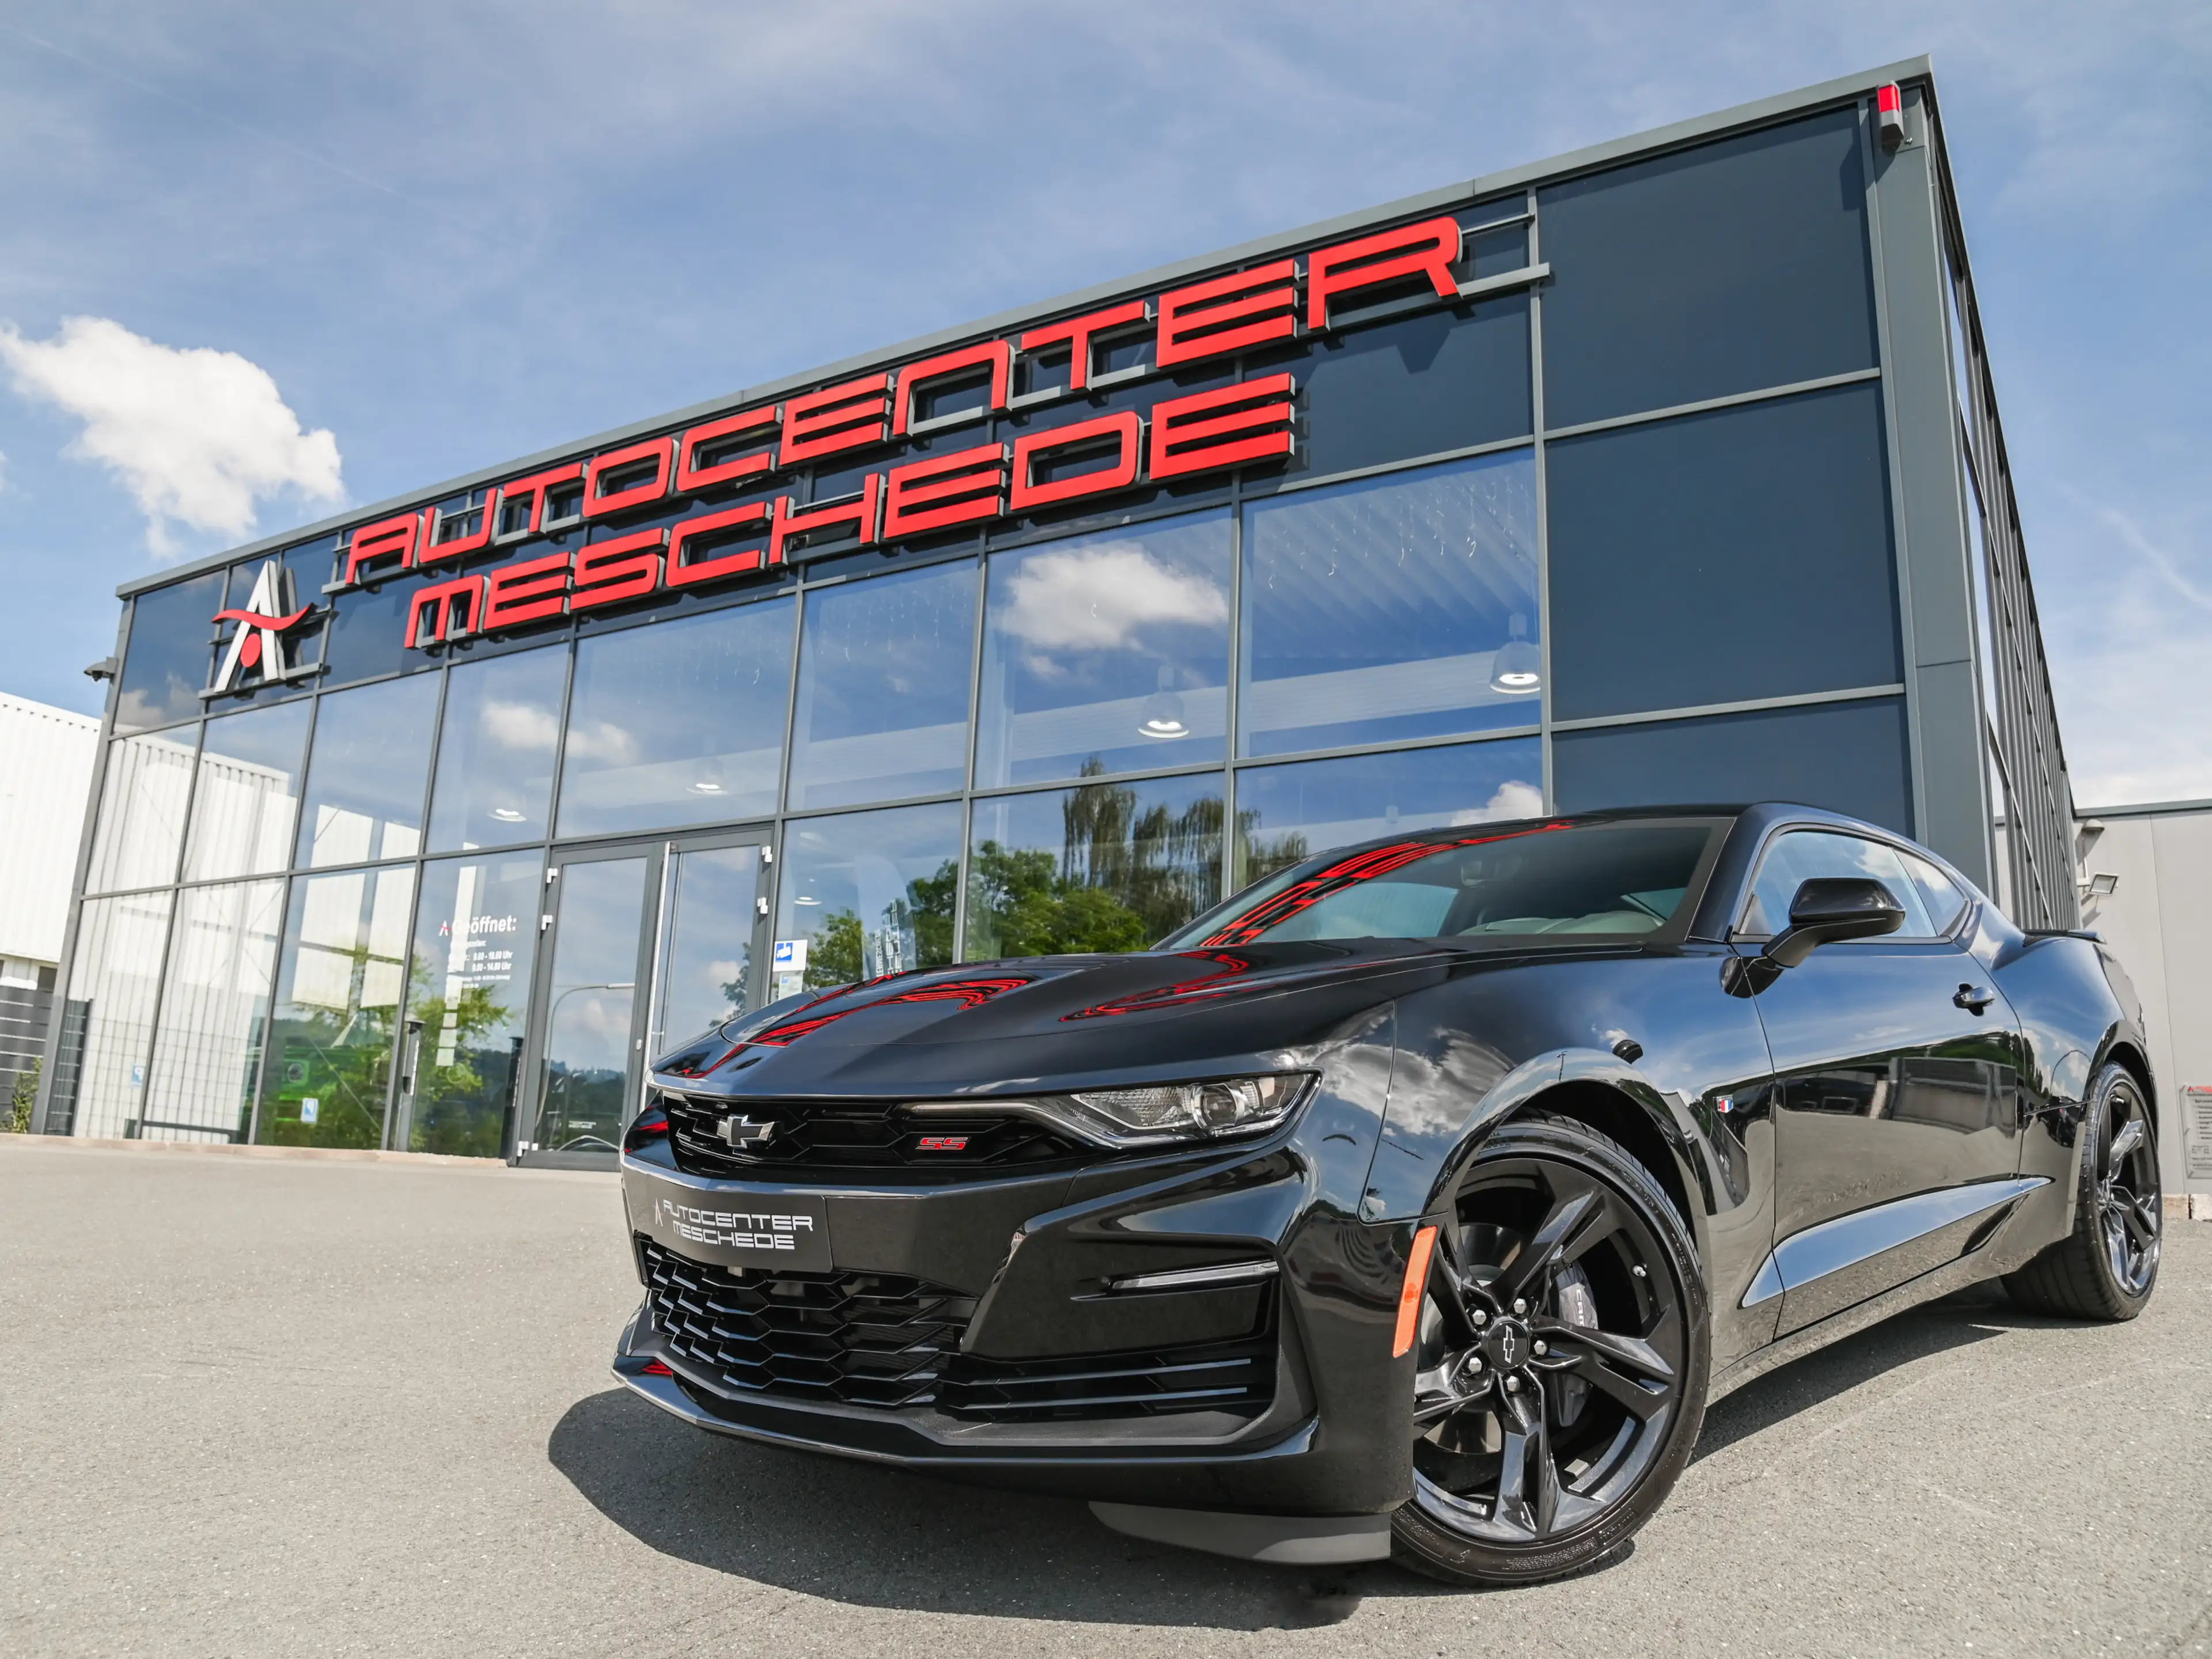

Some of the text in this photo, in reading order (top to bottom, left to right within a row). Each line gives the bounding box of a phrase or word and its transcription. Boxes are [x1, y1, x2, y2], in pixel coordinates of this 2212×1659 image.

[346, 217, 1464, 587] AUTOCENTER
[406, 372, 1296, 649] MESCHEDE
[915, 1137, 969, 1150] SS
[663, 1198, 813, 1232] AUTOCENTER
[673, 1219, 795, 1250] MESCHEDE
